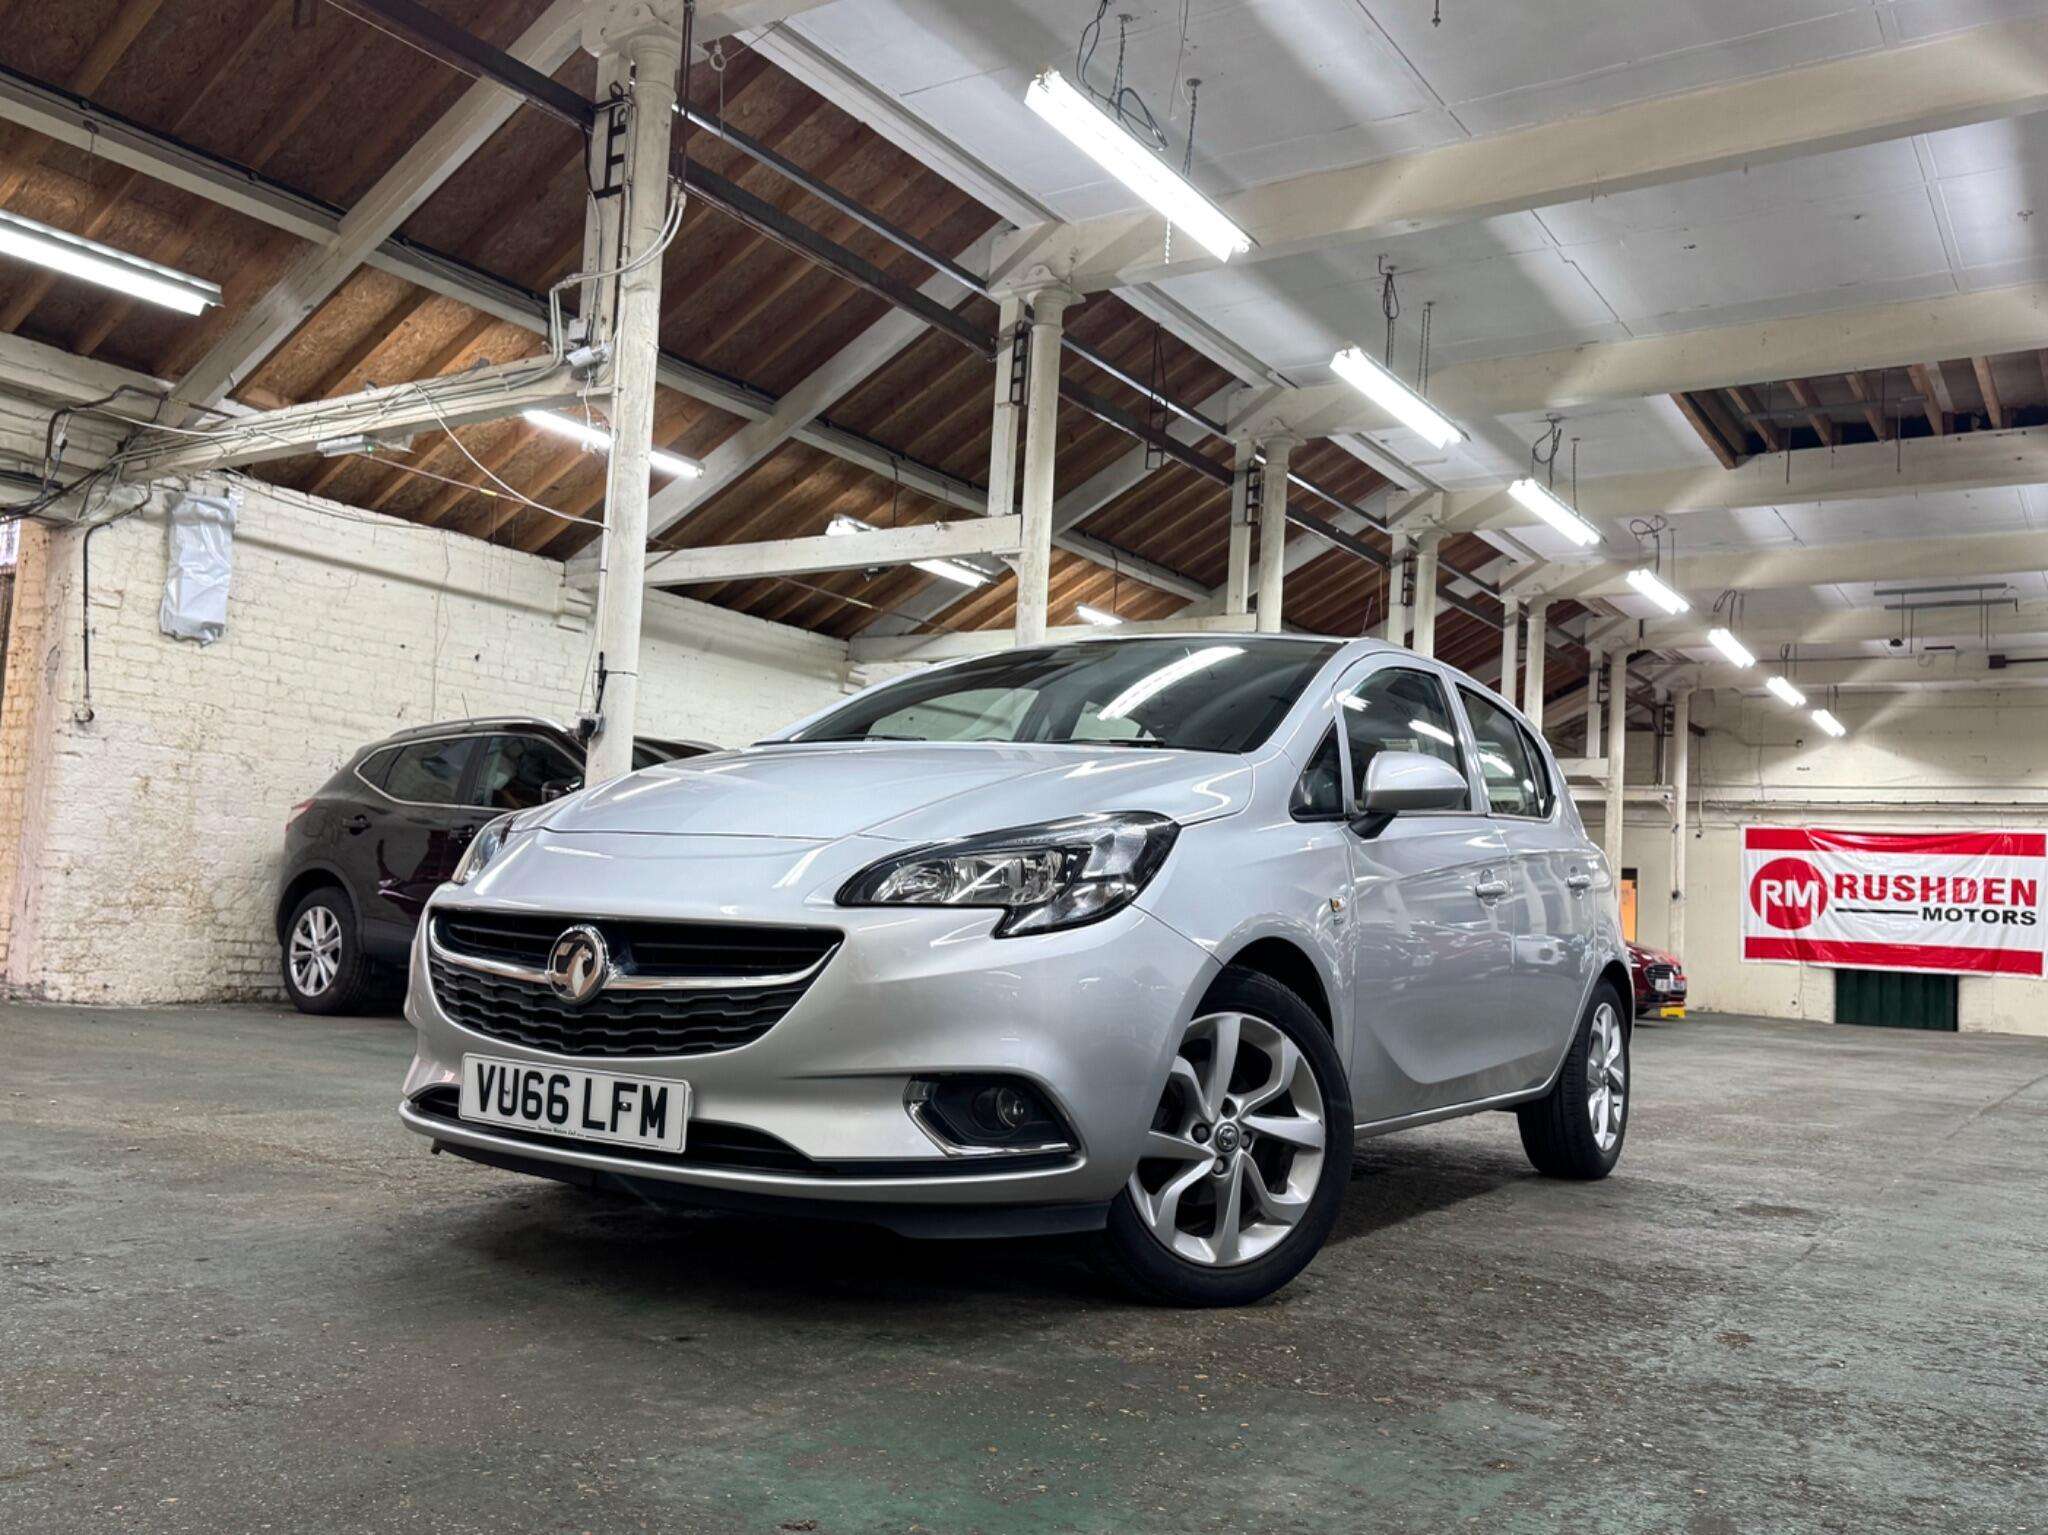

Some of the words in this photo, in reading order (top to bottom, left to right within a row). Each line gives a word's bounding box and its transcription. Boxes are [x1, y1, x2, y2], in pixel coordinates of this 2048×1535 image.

[1759, 879, 1819, 912] RM
[1834, 874, 2037, 907] RUSHDEN
[1922, 907, 2037, 926] MOTORS
[477, 1063, 570, 1125] VU66
[582, 1077, 668, 1139] LFM
